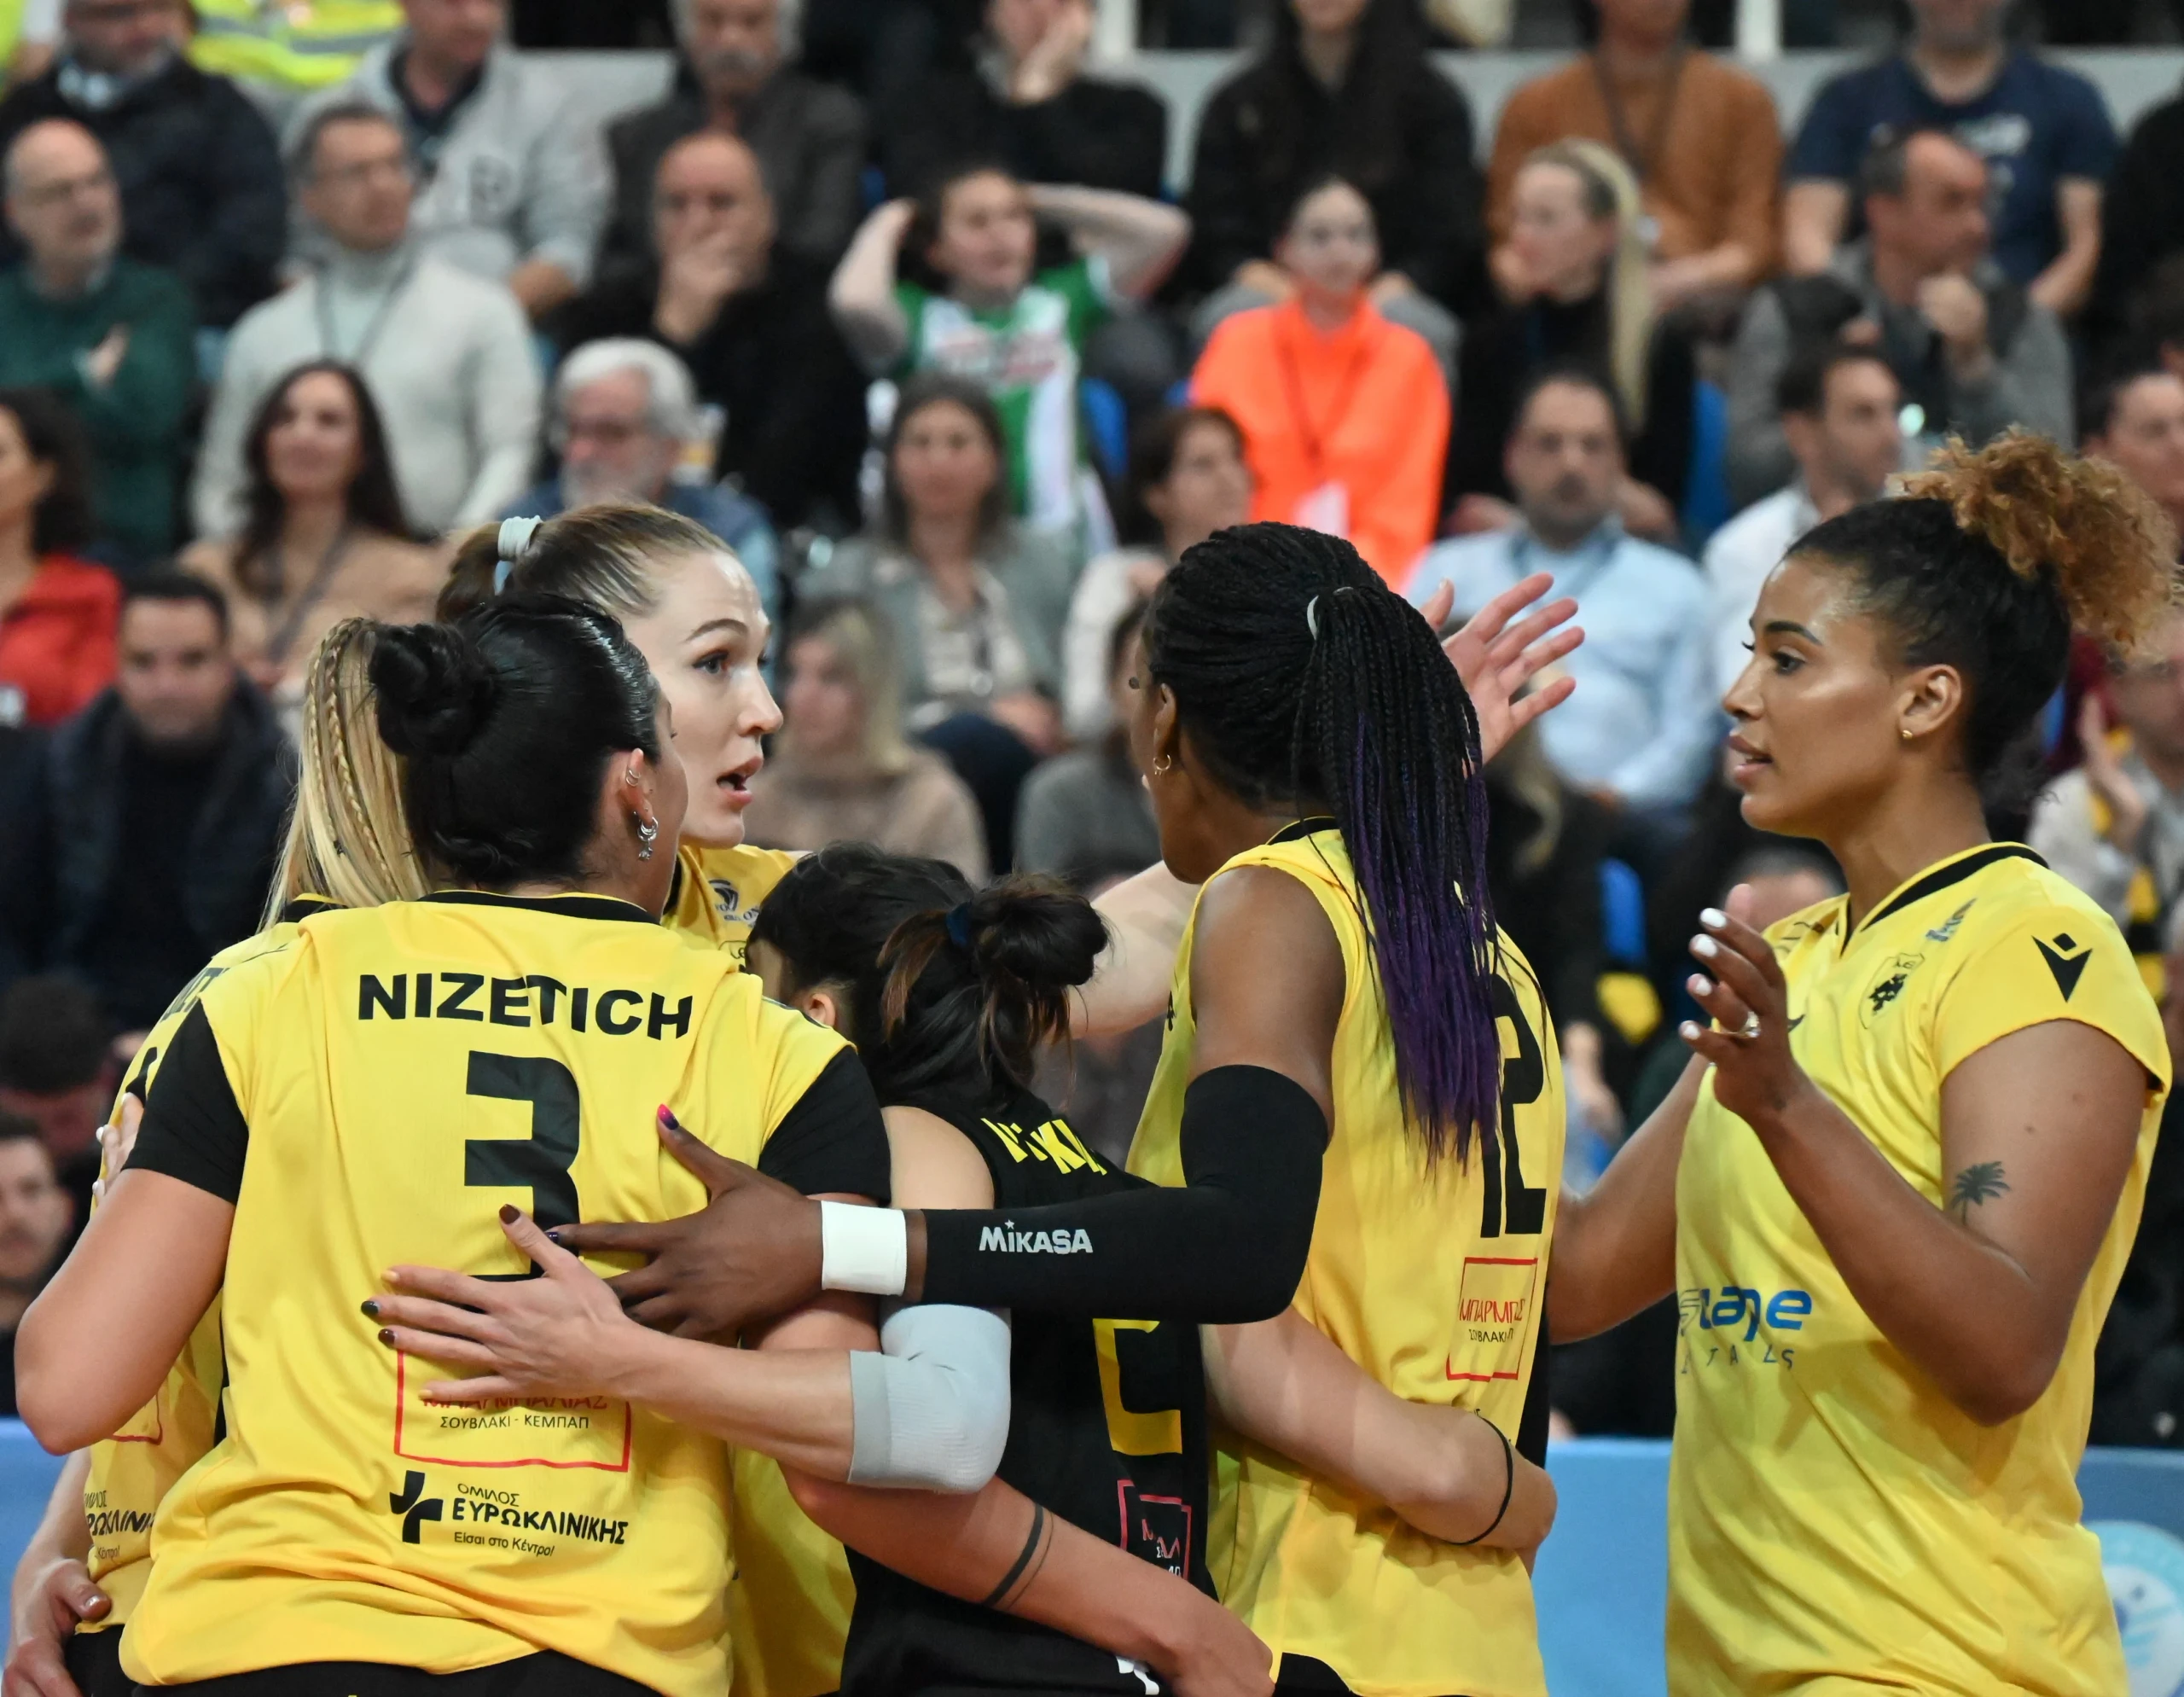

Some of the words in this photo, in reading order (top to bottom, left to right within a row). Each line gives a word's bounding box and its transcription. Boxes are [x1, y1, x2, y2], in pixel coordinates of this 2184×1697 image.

[358, 972, 693, 1040] NIZETICH
[464, 1050, 580, 1305] 3
[440, 1415, 510, 1429] ΣΟΥΒΛΑΚΙ
[524, 1415, 589, 1429] ΚΕΜΠΑΠ
[457, 1483, 520, 1507] ΟΜΙΛΟΣ
[452, 1497, 629, 1544] ΕΥΡΩΚΛΙΝΙΚΗΣ
[454, 1531, 485, 1545] Είσαι
[489, 1537, 508, 1549] στο
